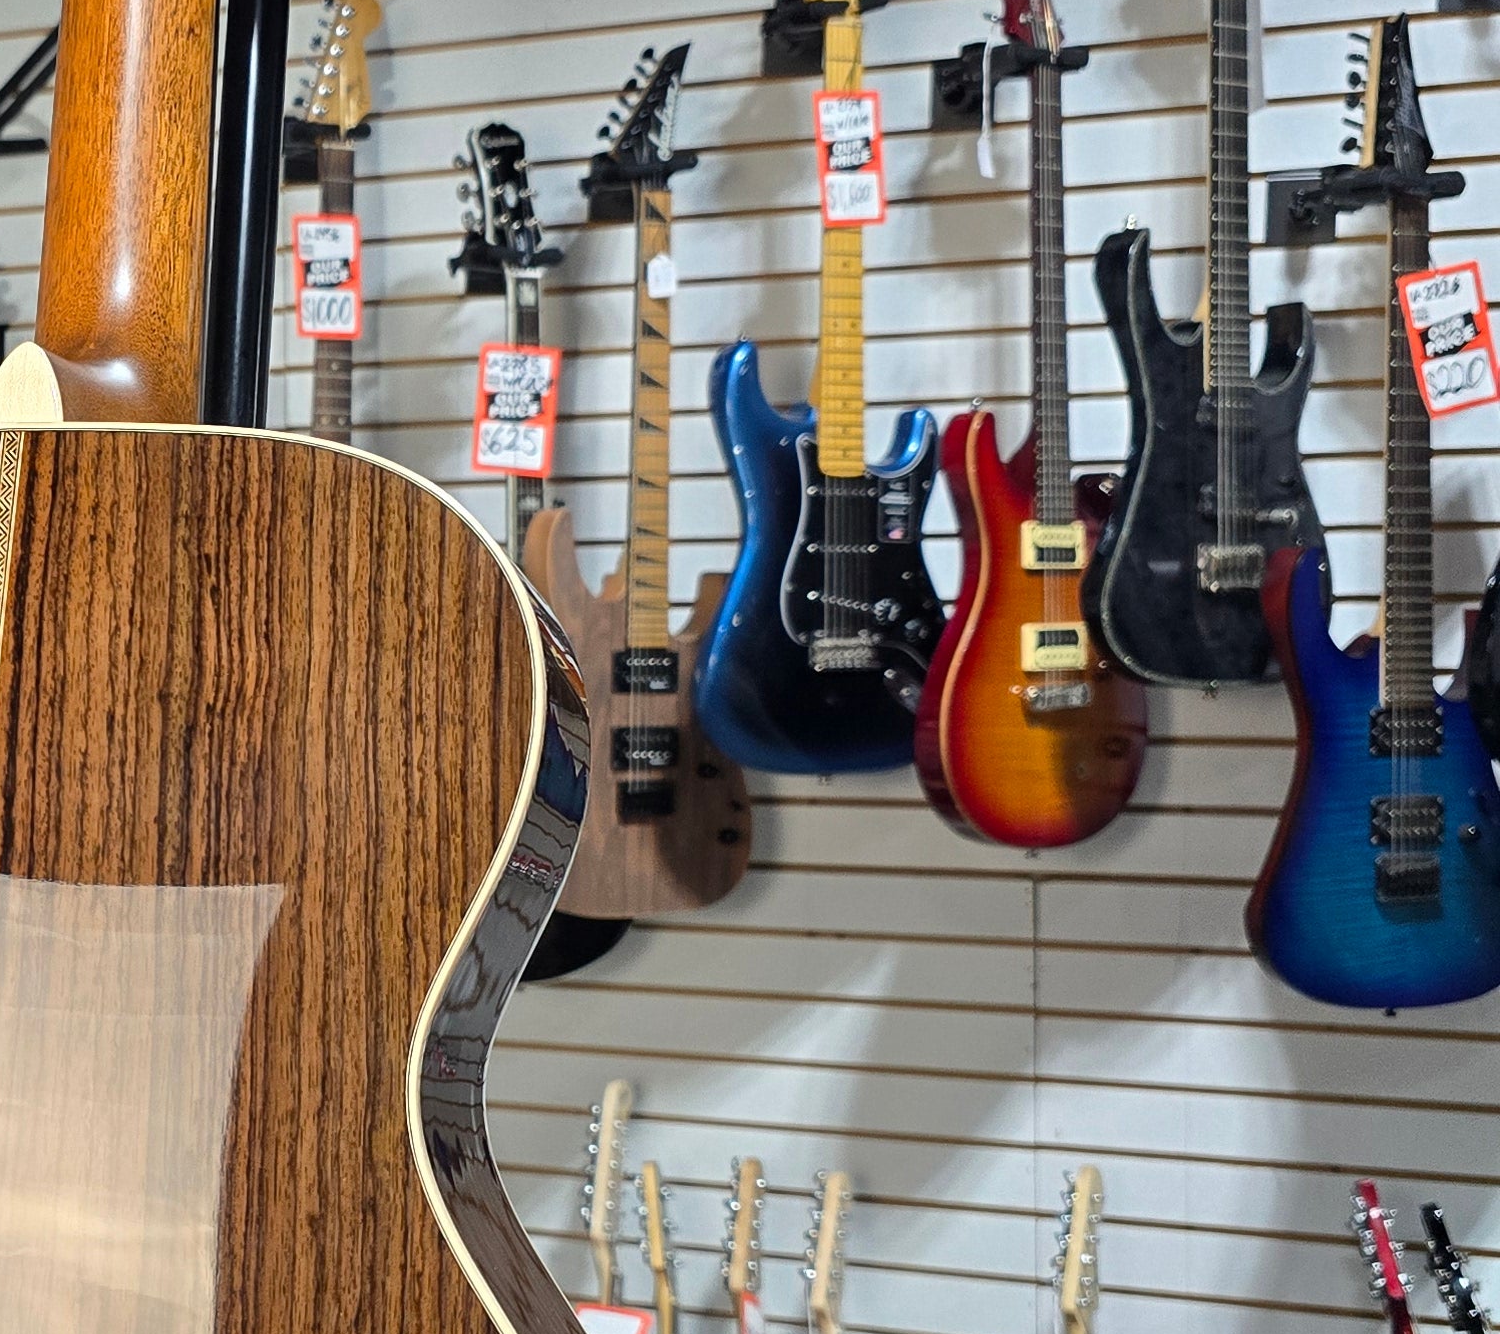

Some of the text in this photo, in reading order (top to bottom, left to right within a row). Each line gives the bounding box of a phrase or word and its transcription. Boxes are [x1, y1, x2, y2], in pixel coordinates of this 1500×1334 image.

[1424, 323, 1475, 358] PRICE
[1427, 317, 1465, 341] OUR
[1426, 355, 1486, 401] $220
[488, 401, 541, 420] PRICE
